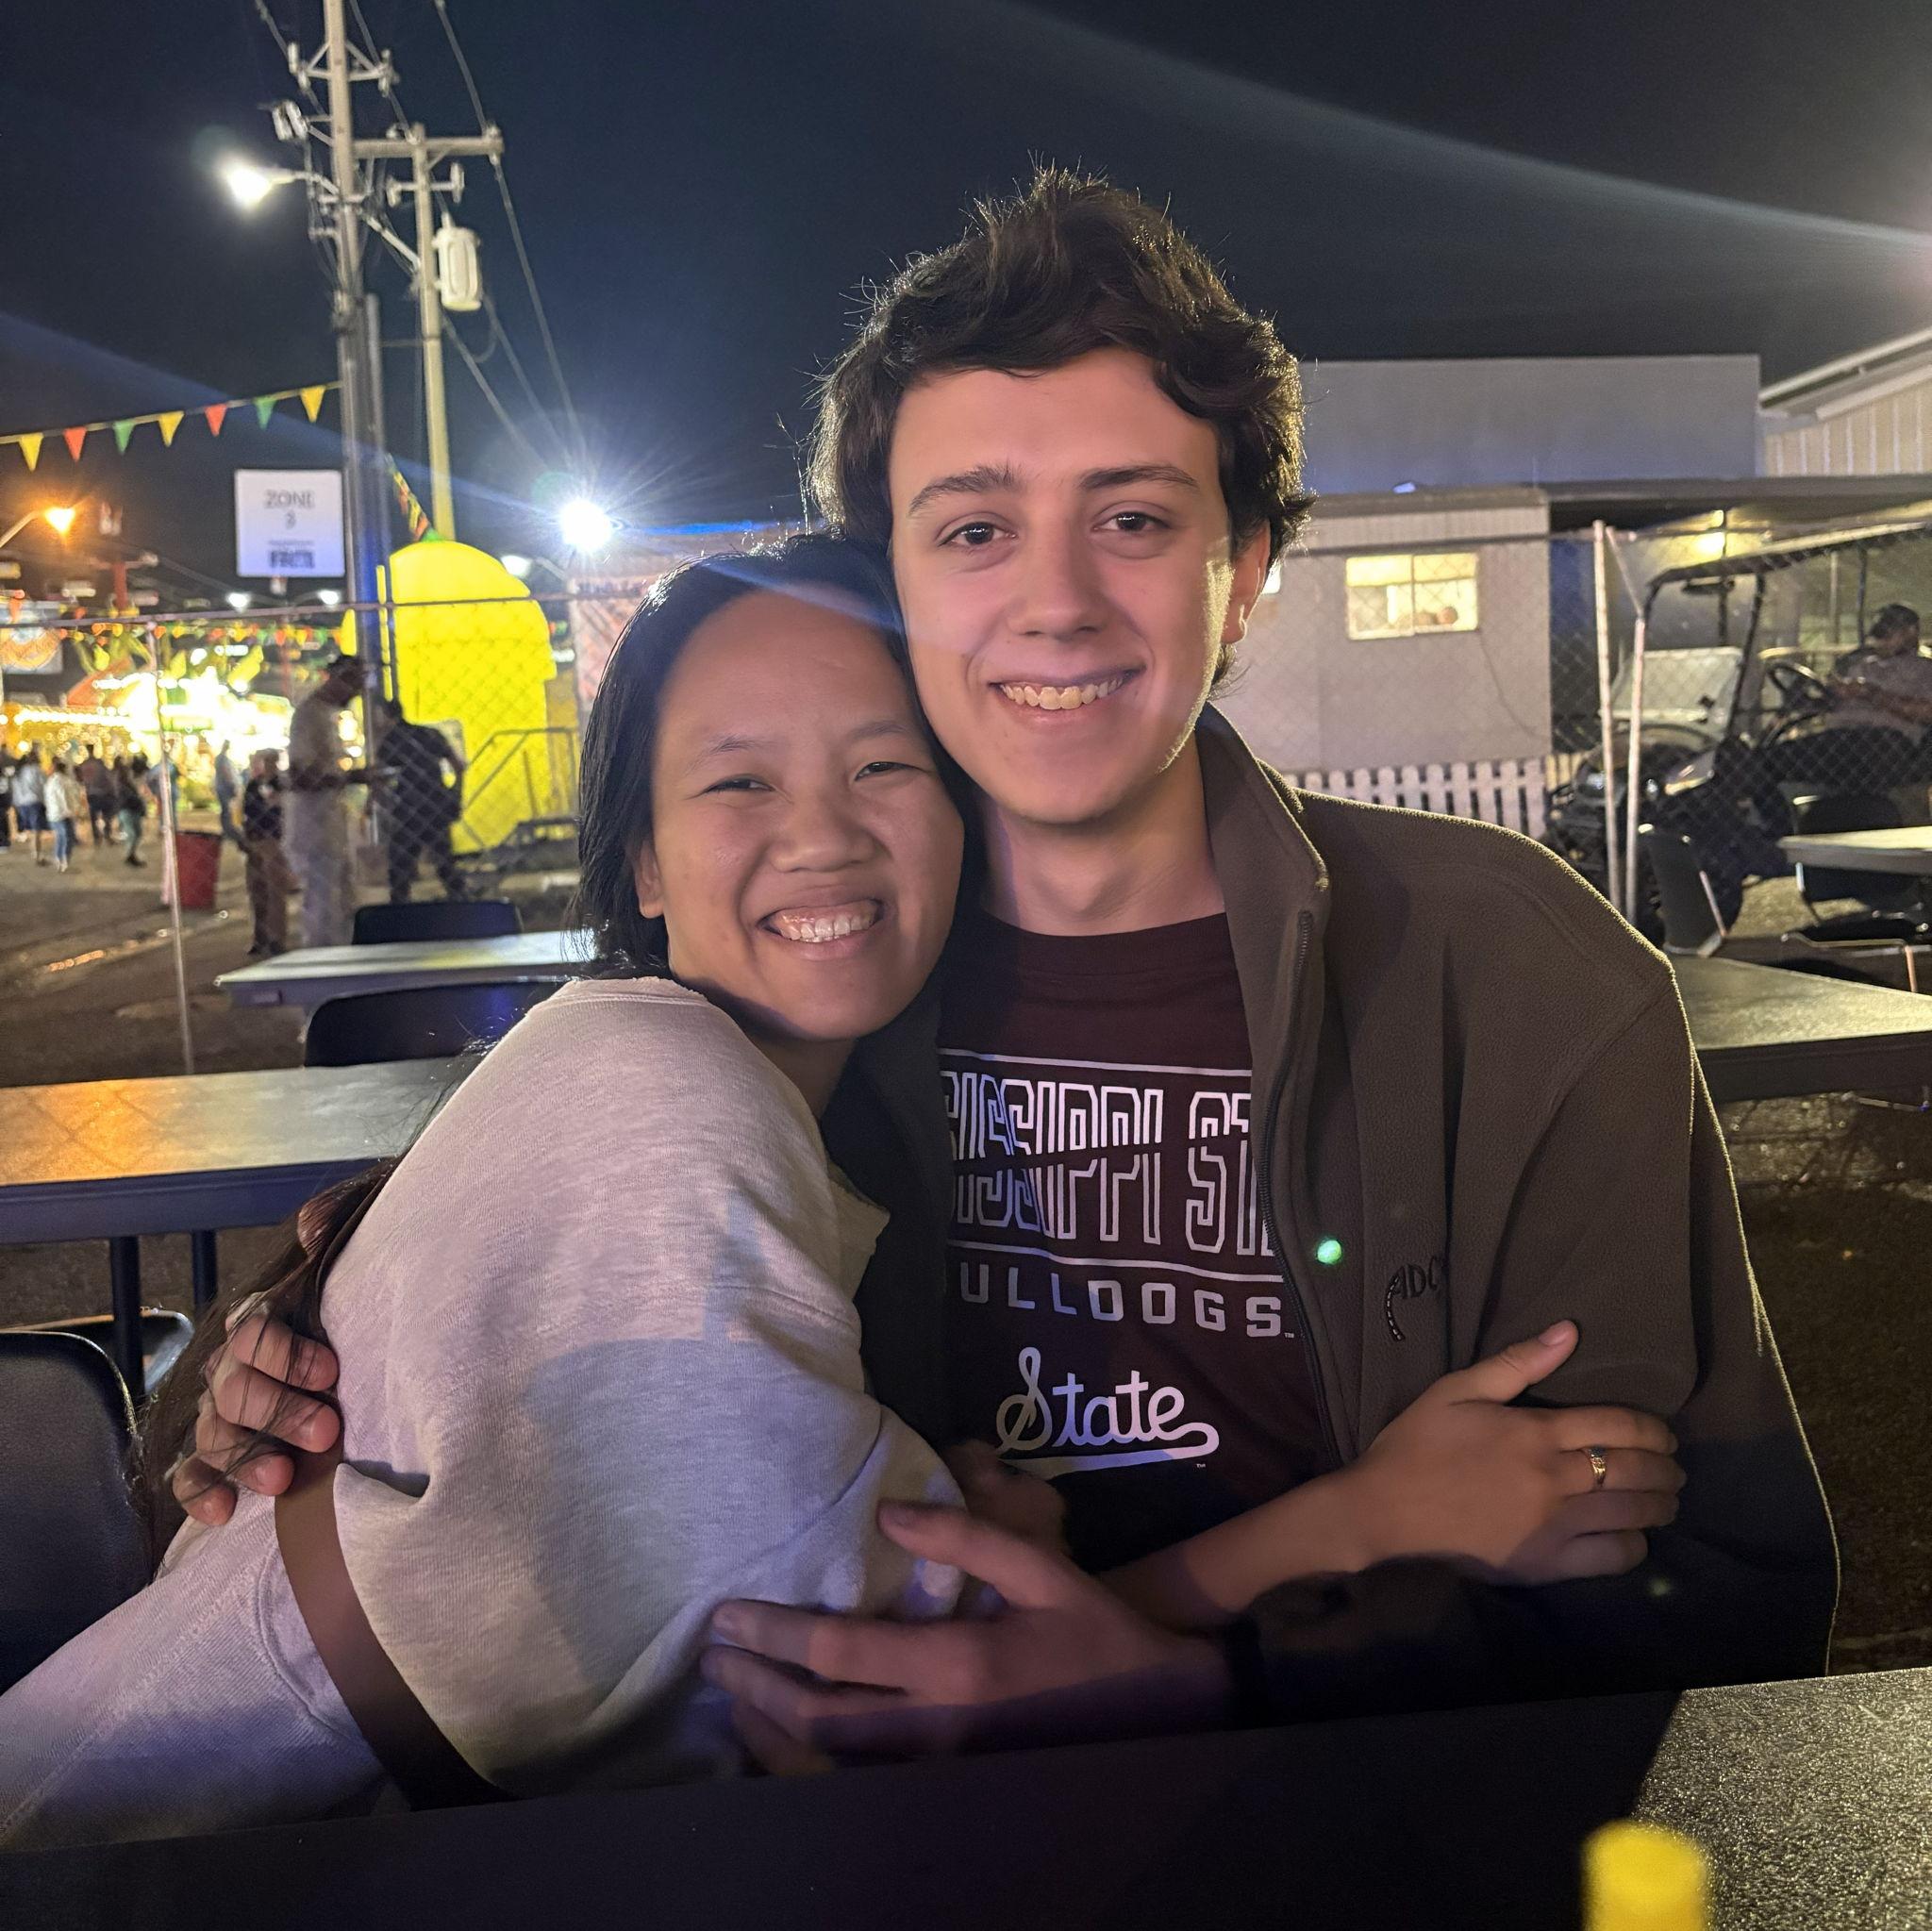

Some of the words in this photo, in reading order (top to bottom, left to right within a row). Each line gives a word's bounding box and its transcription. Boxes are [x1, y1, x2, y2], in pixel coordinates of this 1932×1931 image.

[265, 490, 316, 508] ZONE
[1186, 1091, 1277, 1257] ST
[996, 1346, 1219, 1479] State
